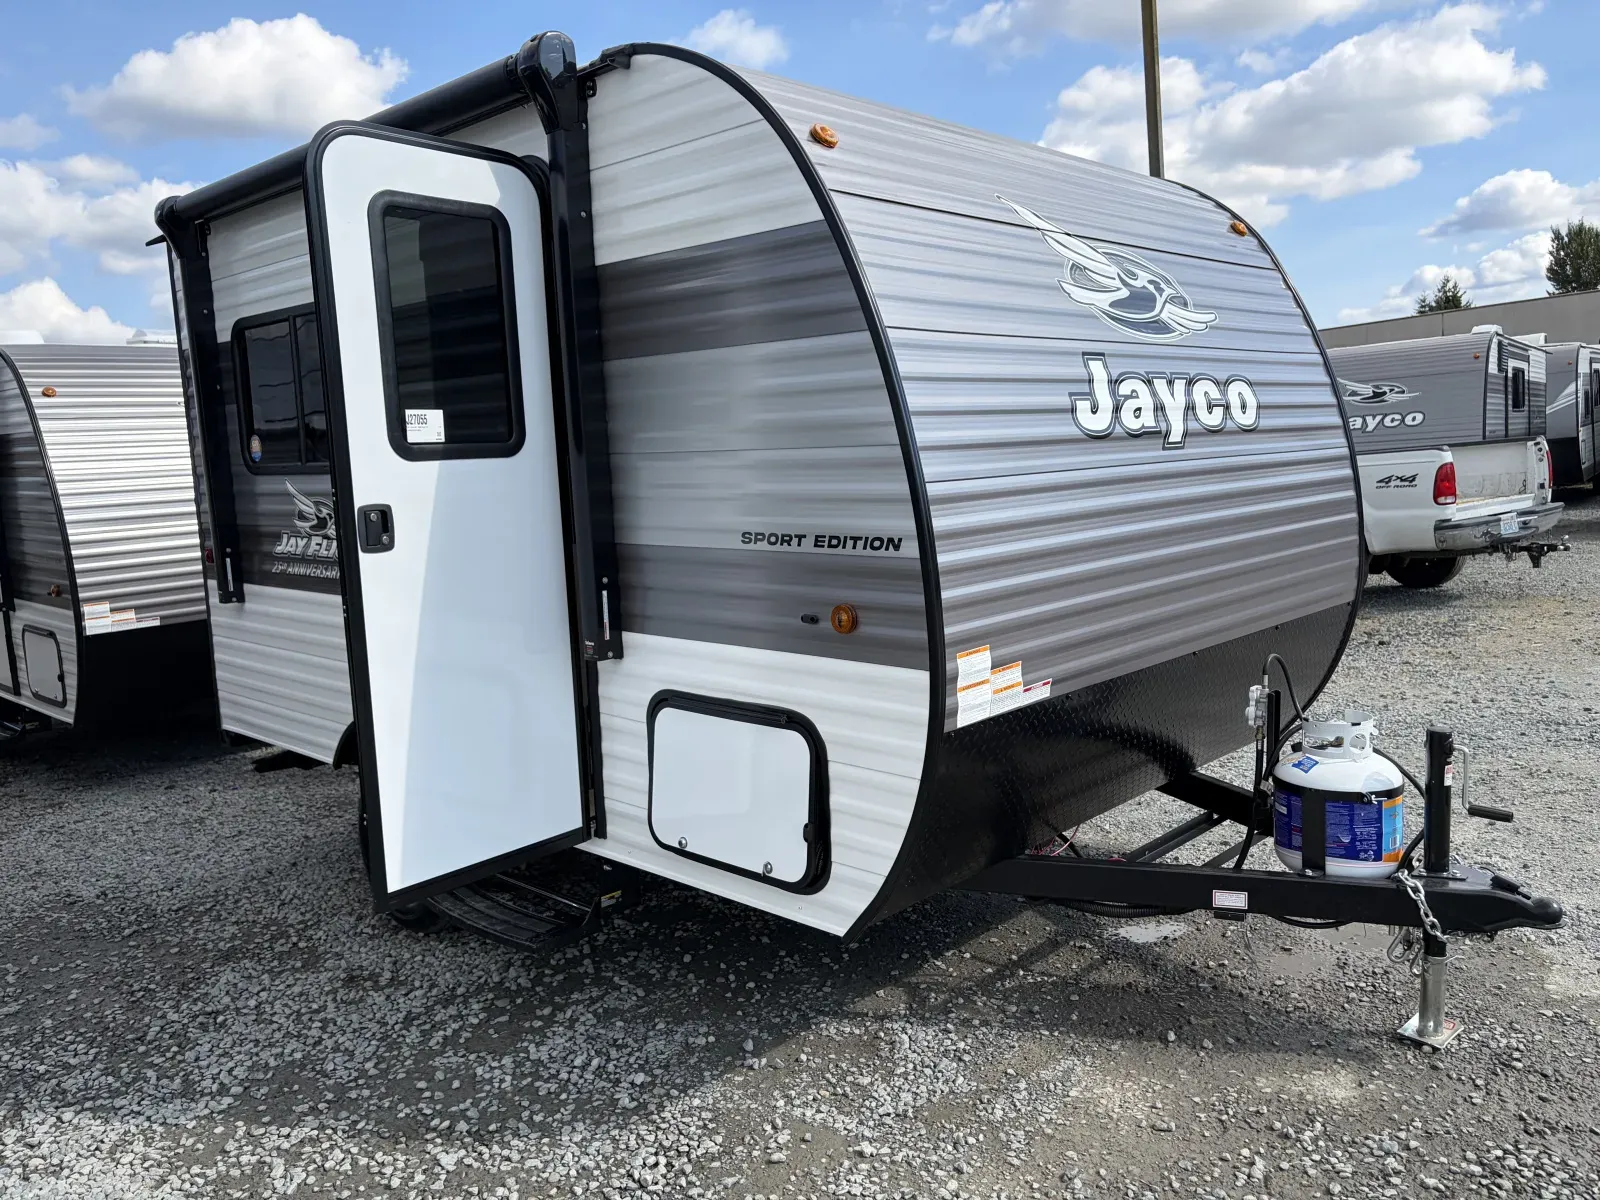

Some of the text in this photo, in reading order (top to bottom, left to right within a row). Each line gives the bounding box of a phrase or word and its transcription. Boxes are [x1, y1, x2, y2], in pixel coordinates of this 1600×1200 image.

[1068, 351, 1259, 450] Jayco
[406, 413, 428, 425] J27055
[1348, 410, 1426, 433] ayco
[273, 531, 338, 561] JAY FLI
[740, 531, 903, 552] SPORT EDITION
